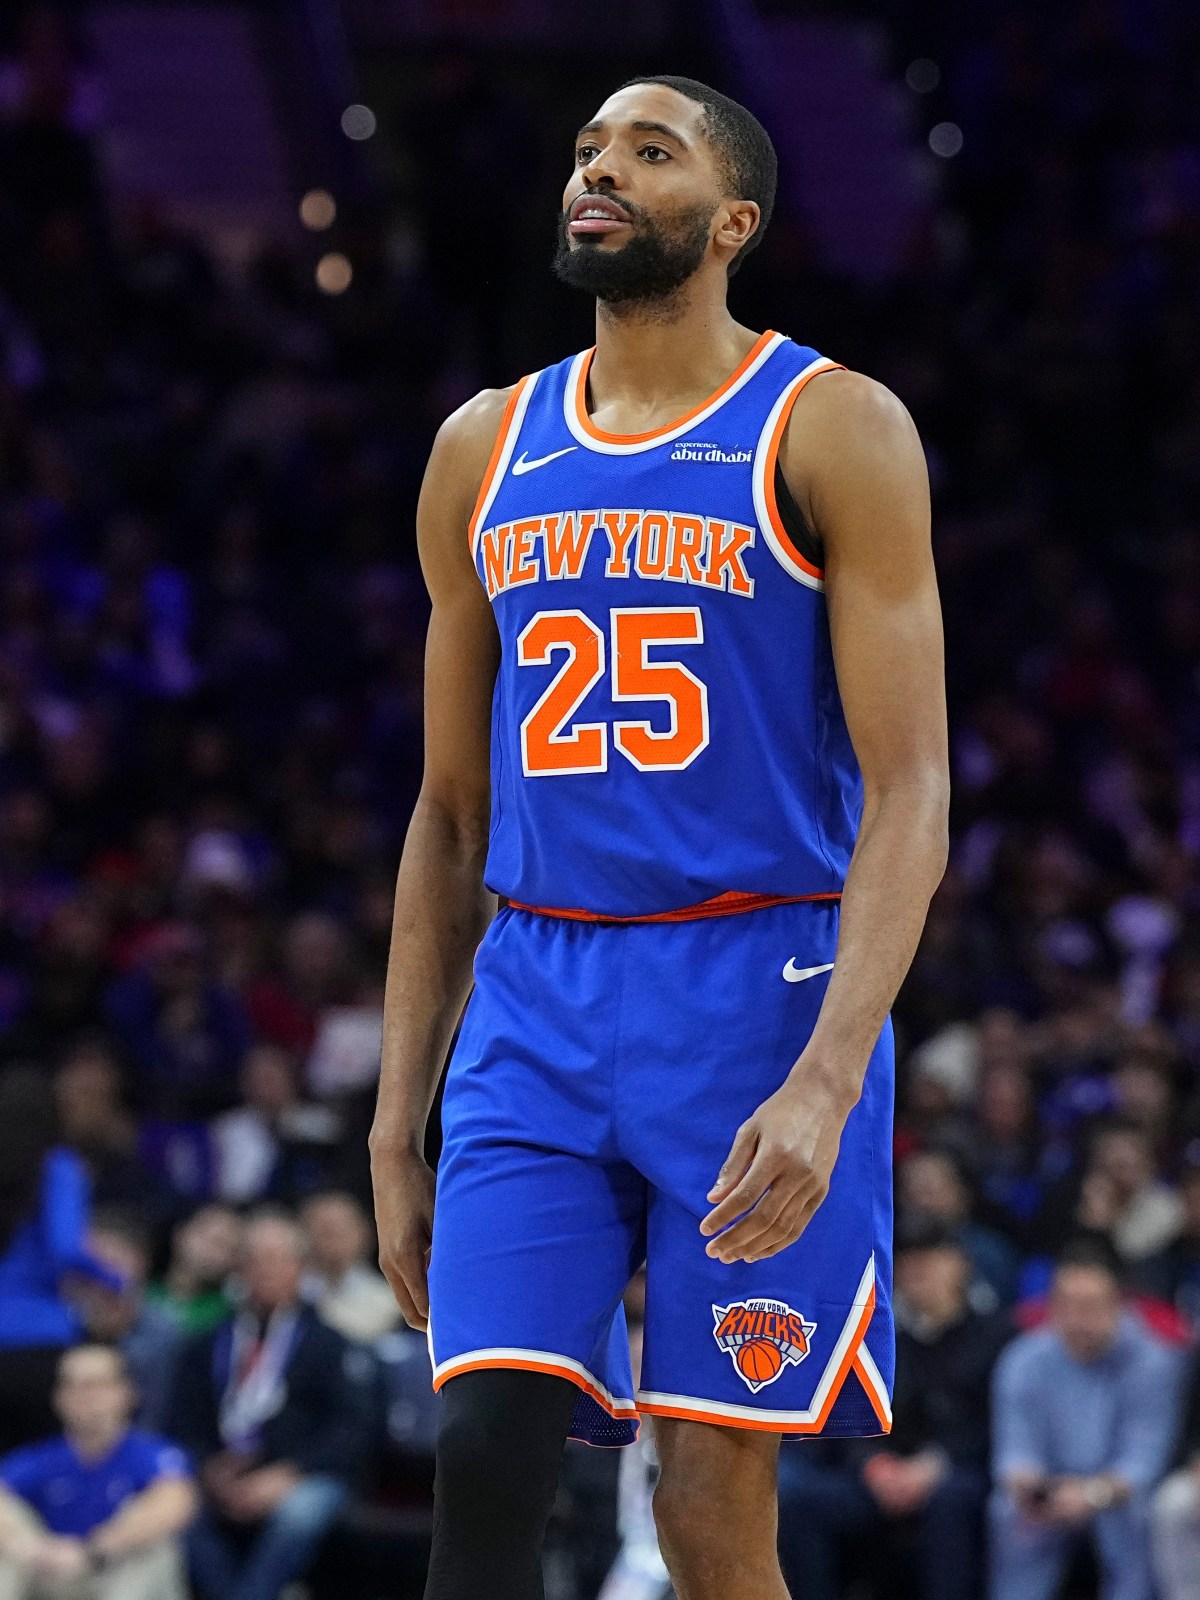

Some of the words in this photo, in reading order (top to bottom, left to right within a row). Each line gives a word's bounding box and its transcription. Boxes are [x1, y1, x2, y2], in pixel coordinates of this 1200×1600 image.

[671, 448, 703, 461] abu
[705, 449, 753, 463] dhabi
[481, 511, 599, 602] NEW
[599, 509, 756, 599] YORK
[517, 606, 710, 777] 25
[716, 1305, 808, 1353] KNICKS
[747, 1302, 766, 1311] NEW
[767, 1303, 787, 1315] YORK
